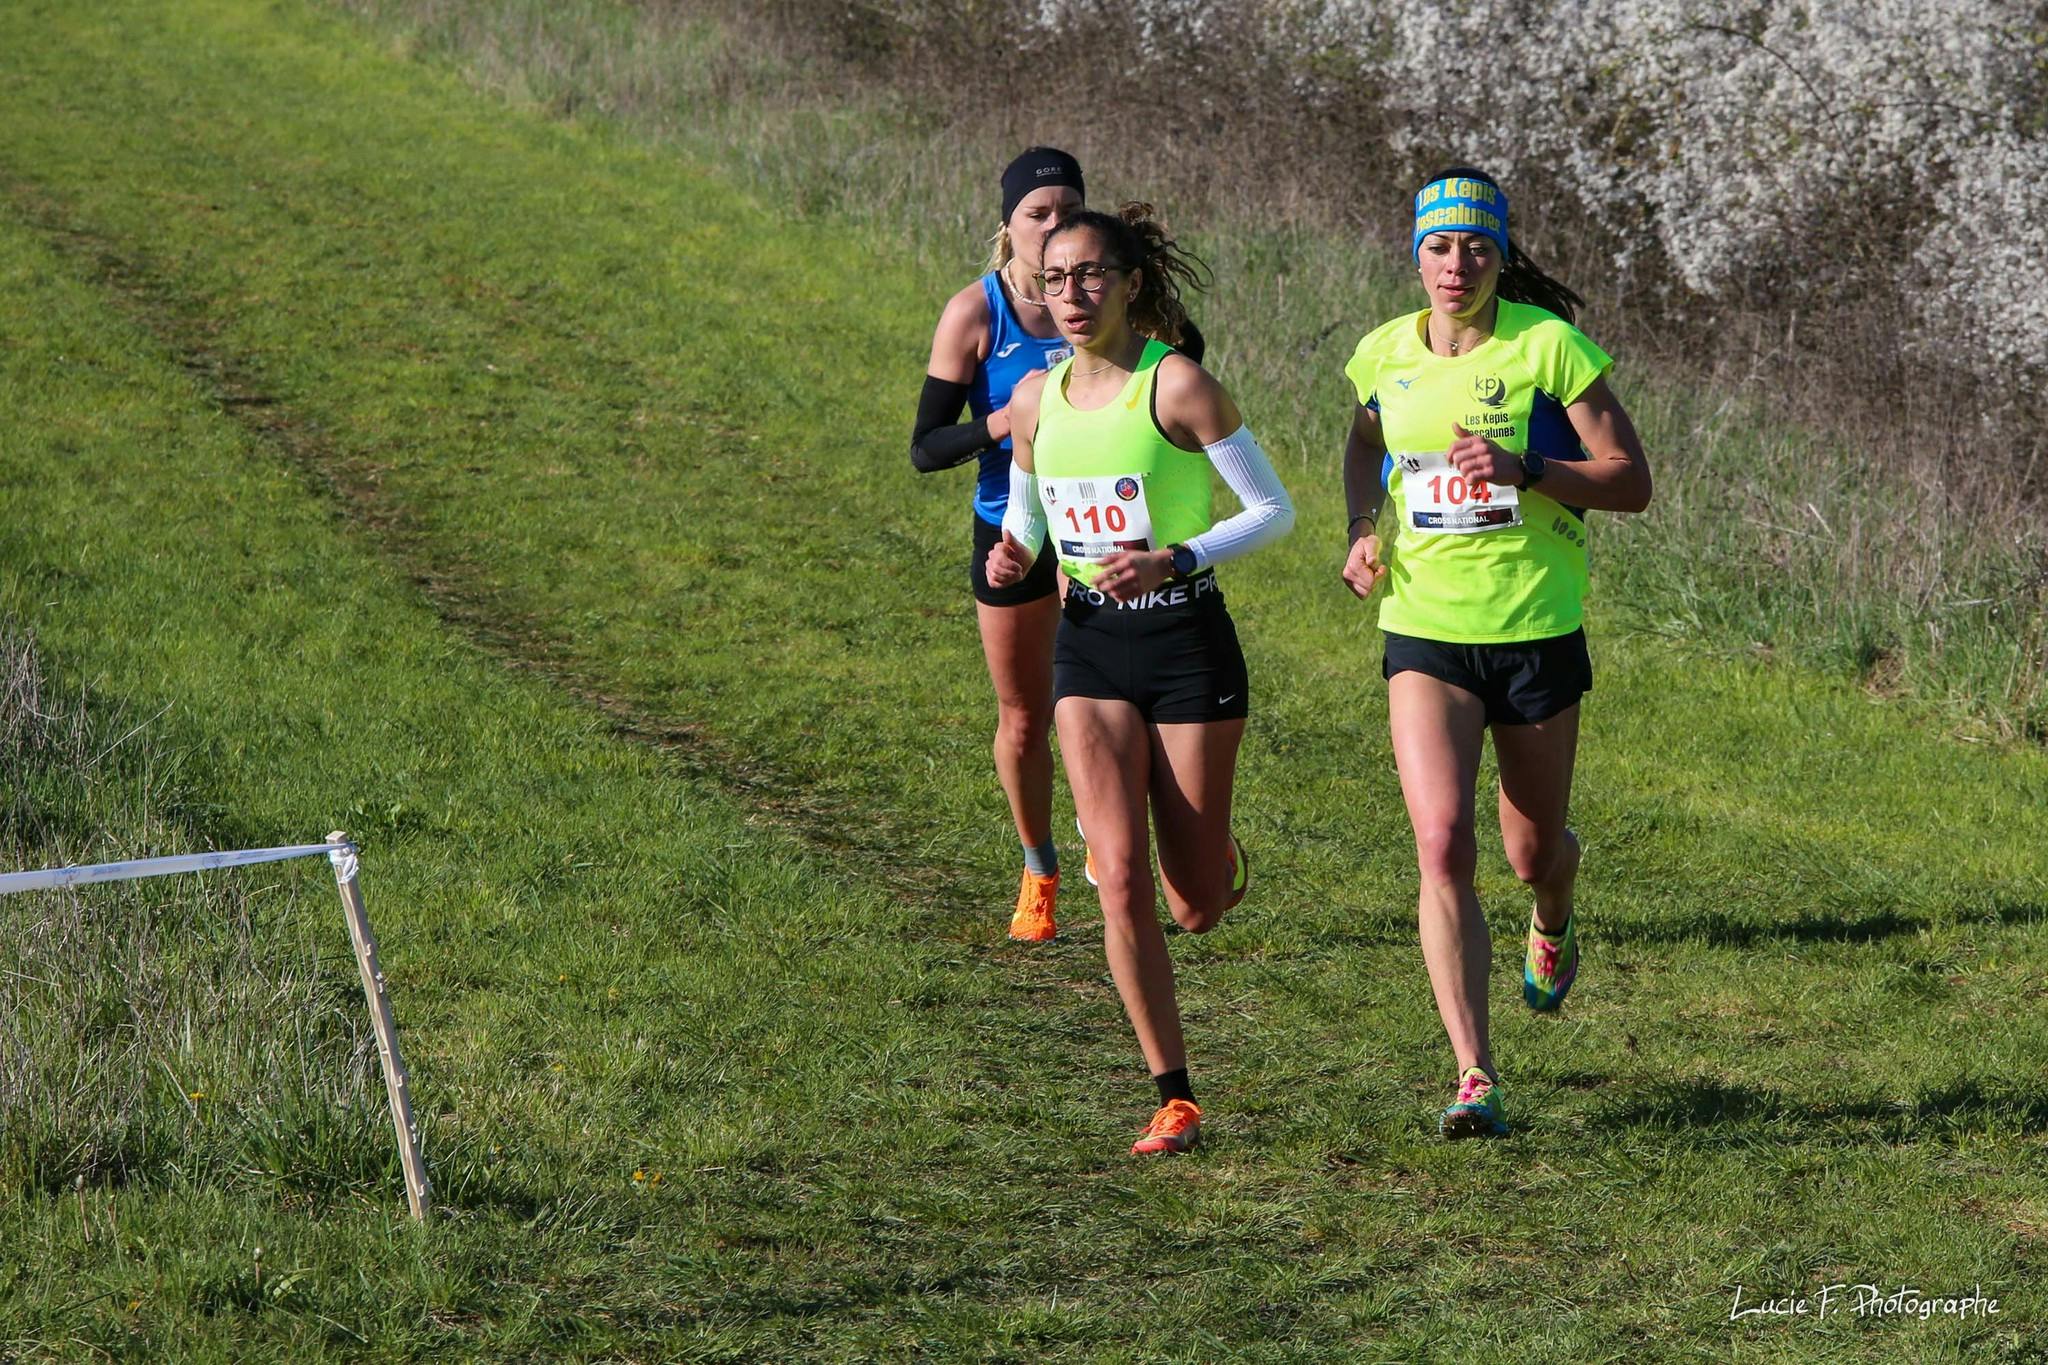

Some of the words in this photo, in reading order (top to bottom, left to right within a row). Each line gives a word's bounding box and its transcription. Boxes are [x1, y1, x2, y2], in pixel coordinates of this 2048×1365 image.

[1418, 185, 1440, 211] Les
[1465, 414, 1480, 426] Les
[1427, 475, 1492, 505] 104
[1065, 505, 1126, 534] 110
[1428, 516, 1451, 525] CROSS
[1452, 516, 1489, 525] NATIONAL
